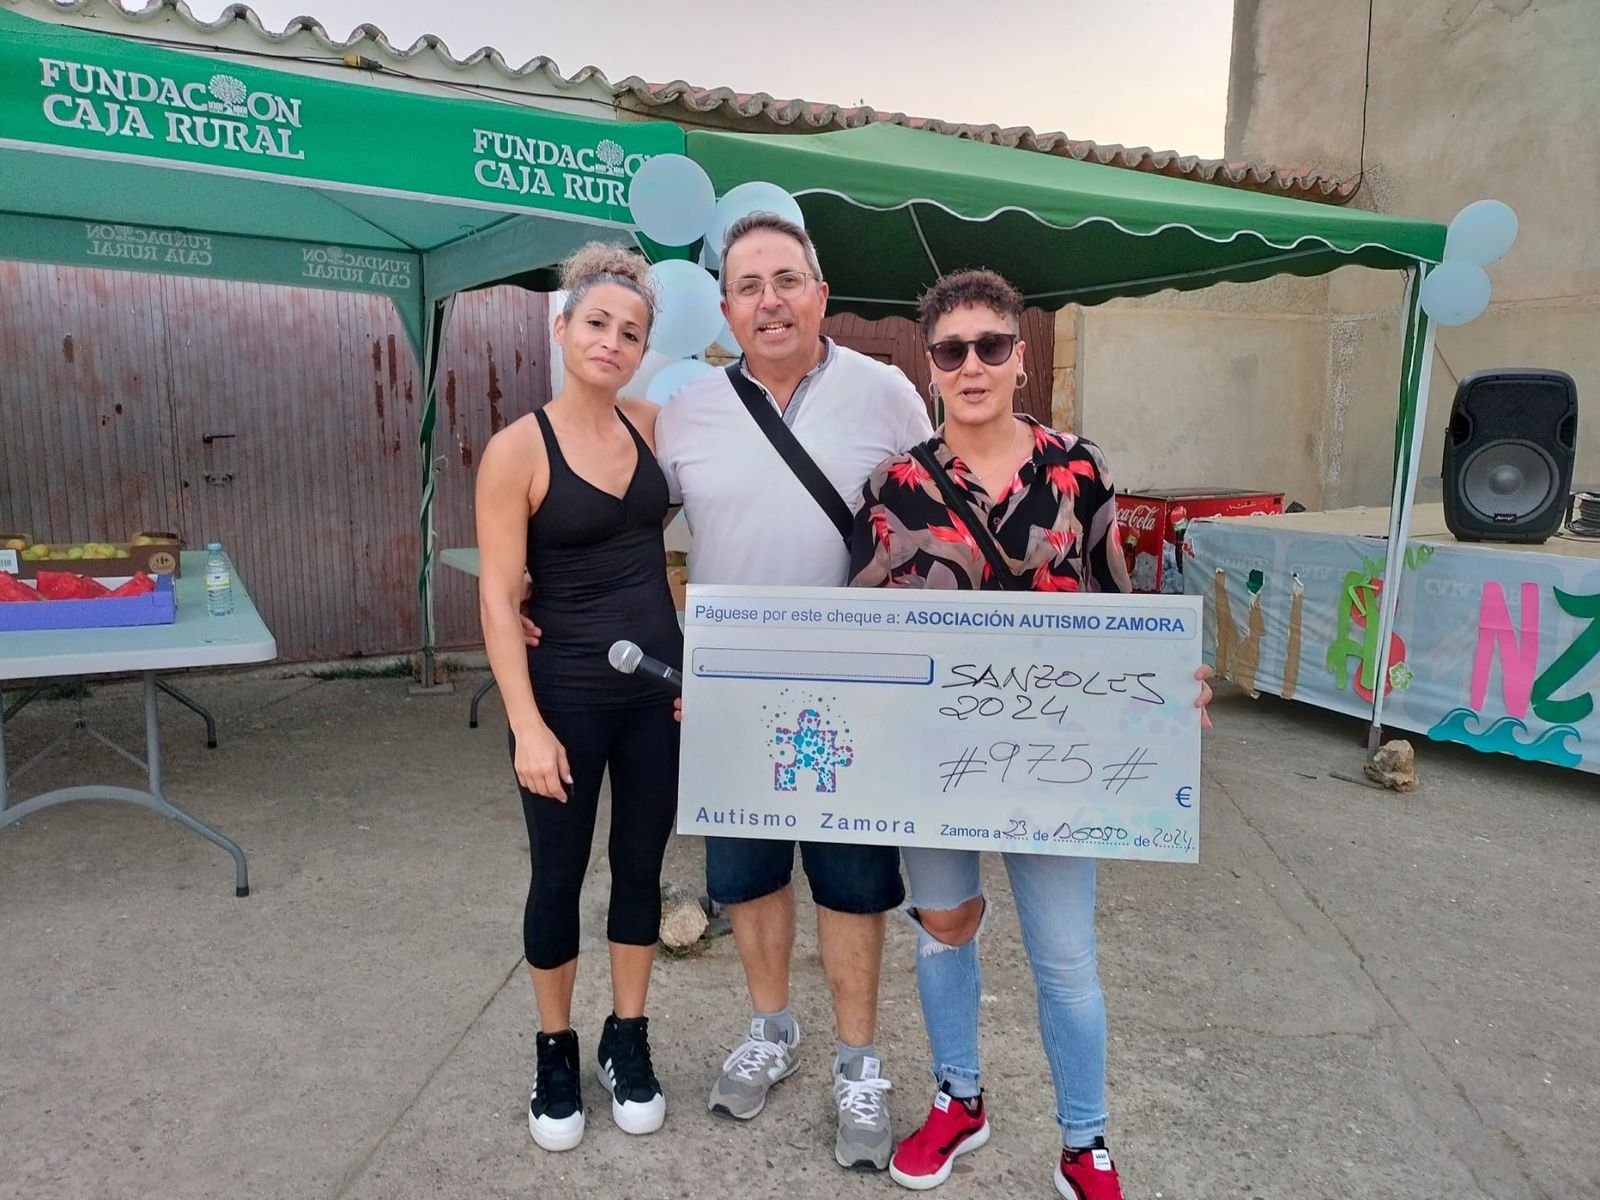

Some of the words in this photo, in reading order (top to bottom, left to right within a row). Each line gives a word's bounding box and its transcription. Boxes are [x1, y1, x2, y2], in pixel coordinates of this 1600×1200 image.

[43, 93, 154, 140] CAJA
[164, 111, 305, 160] RURAL
[474, 160, 555, 197] CAJA
[563, 173, 629, 208] RUR
[695, 605, 758, 622] Páguese
[763, 609, 787, 623] por
[791, 609, 822, 622] este
[827, 609, 882, 626] cheque
[886, 612, 901, 624] a:
[905, 610, 1014, 628] ASOCIACIÓN
[1019, 614, 1100, 630] AUTISMO
[1105, 616, 1185, 632] ZAMORA
[942, 664, 1165, 704] SANZOLES
[939, 695, 1069, 724] 2024
[1175, 786, 1193, 808] €
[695, 807, 797, 828] Autismo
[820, 812, 916, 834] Zamora
[940, 824, 989, 839] Zamora
[993, 829, 1001, 838] a
[1002, 820, 1028, 837] 23
[1033, 829, 1049, 841] de
[1134, 836, 1150, 847] de
[1153, 828, 1193, 852] 2024
